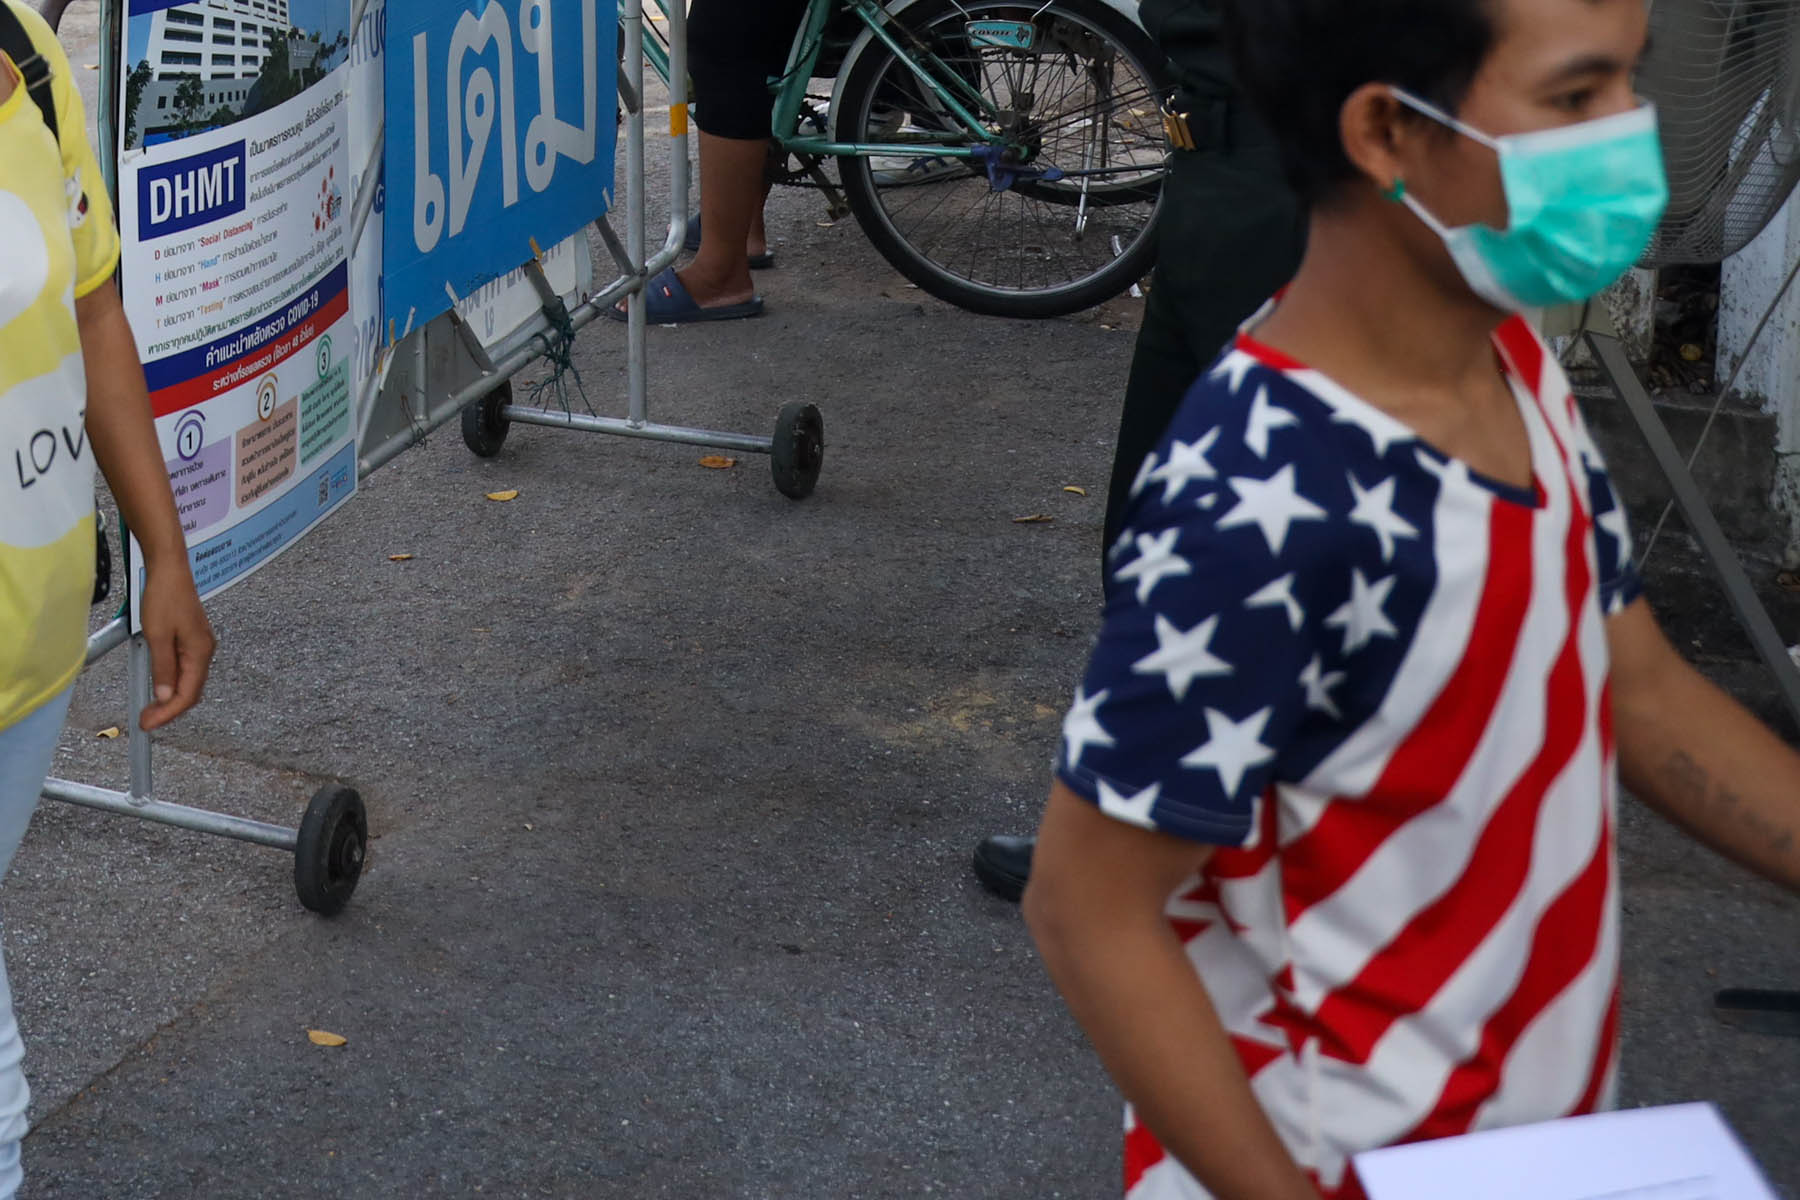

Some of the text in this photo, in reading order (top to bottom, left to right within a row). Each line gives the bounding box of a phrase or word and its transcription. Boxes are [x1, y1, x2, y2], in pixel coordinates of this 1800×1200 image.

[150, 155, 240, 225] DHMT
[155, 249, 161, 261] D
[163, 241, 195, 258] ย่อมาจาก
[155, 272, 161, 283] H
[164, 264, 195, 281] ย่อมาจาก
[155, 295, 163, 306] M
[165, 286, 197, 303] ย่อมาจาก
[157, 319, 161, 328] T
[163, 309, 195, 327] ย่อมาจาก
[206, 290, 320, 368] คำแนะนำหลังตรวจ COVID-19
[321, 352, 327, 371] 3
[264, 392, 270, 412] 2
[15, 409, 86, 491] LOV
[185, 431, 192, 450] 1
